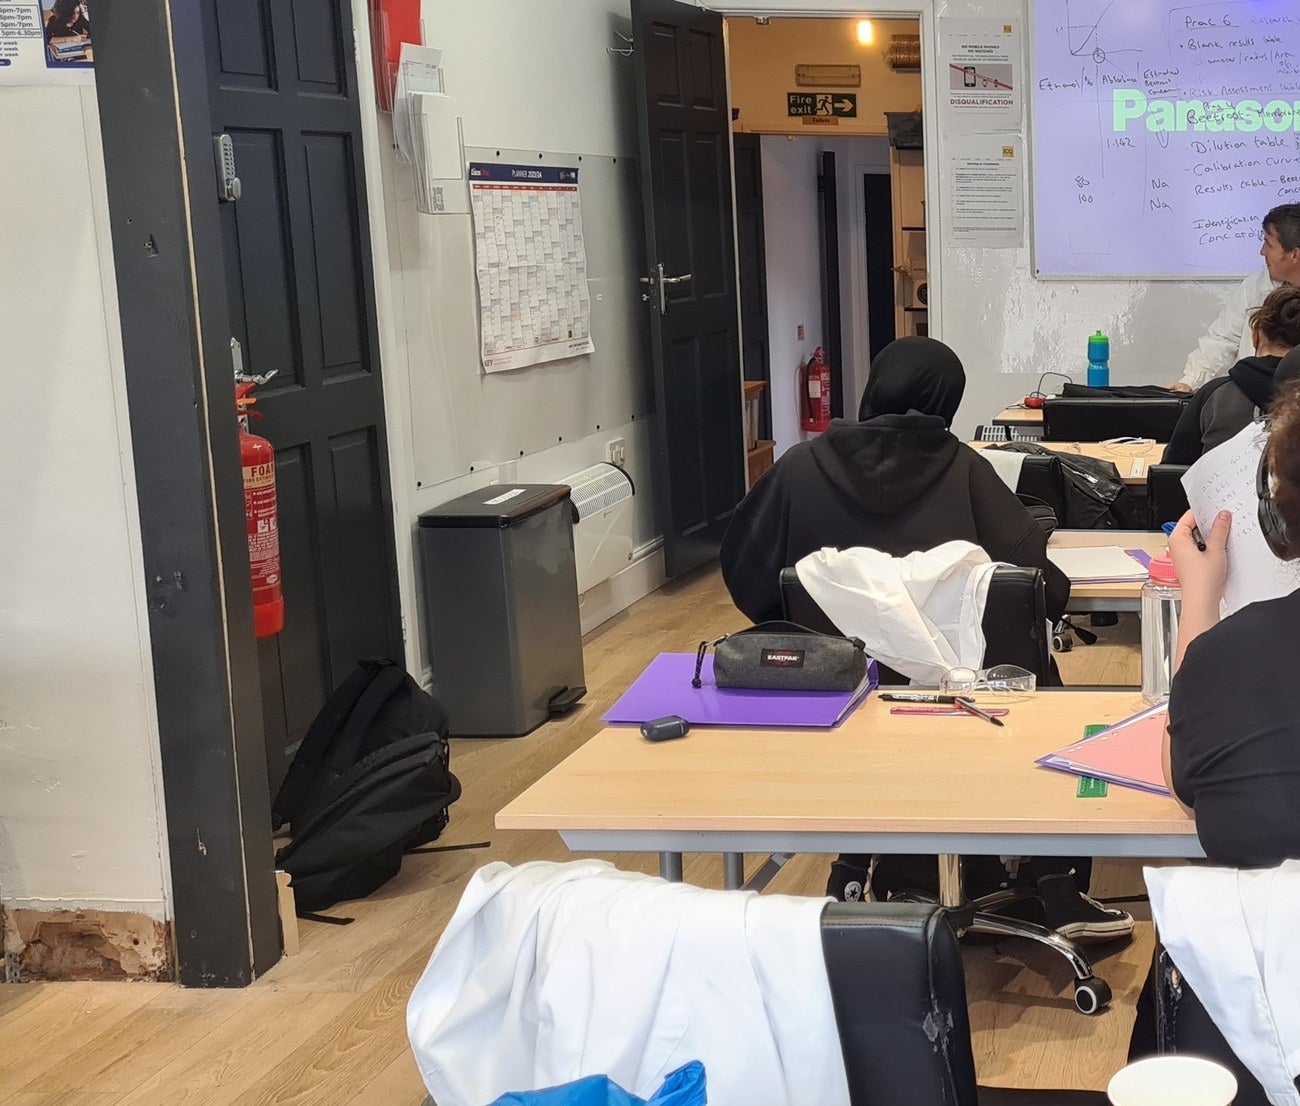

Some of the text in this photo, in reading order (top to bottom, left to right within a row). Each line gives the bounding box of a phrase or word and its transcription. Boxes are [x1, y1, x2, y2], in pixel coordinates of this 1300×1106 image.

[1187, 38, 1224, 51] Blank
[789, 95, 812, 104] Fire
[950, 98, 1014, 106] DISQUALIFICATION
[790, 105, 812, 114] exit
[1191, 139, 1247, 154] Dilution
[1254, 136, 1291, 148] table
[1194, 158, 1262, 176] Calibration
[1195, 183, 1234, 195] Results
[767, 654, 798, 662] EASTPAK
